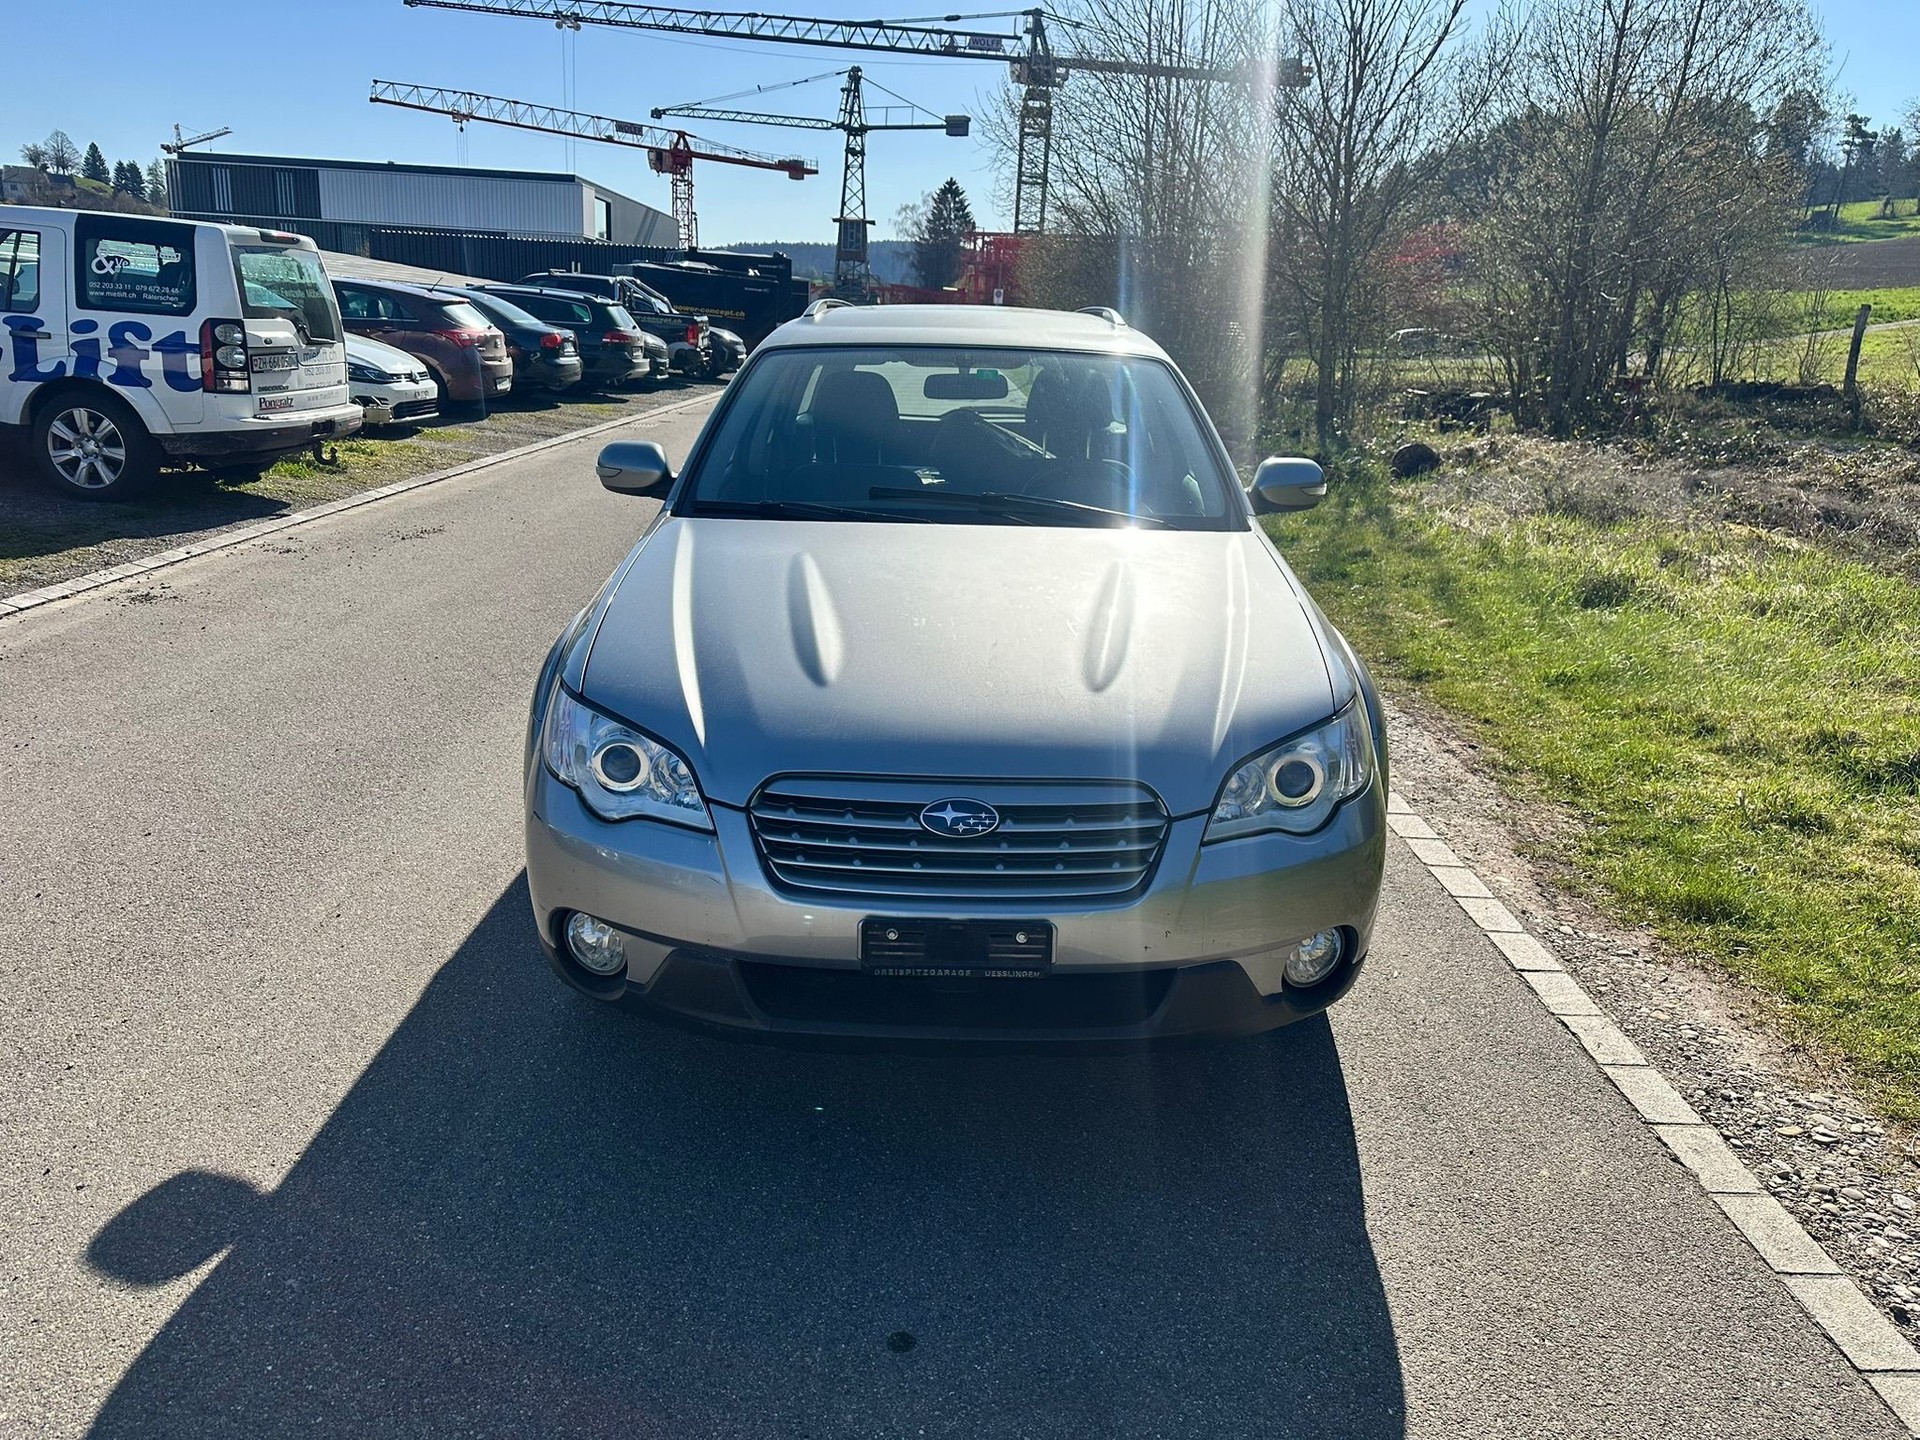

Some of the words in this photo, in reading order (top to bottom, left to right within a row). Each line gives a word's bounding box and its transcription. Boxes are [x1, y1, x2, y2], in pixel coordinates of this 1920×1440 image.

[972, 37, 1002, 47] WOLFF
[89, 290, 137, 299] www.mietlift.ch
[259, 397, 294, 411] Pongratz
